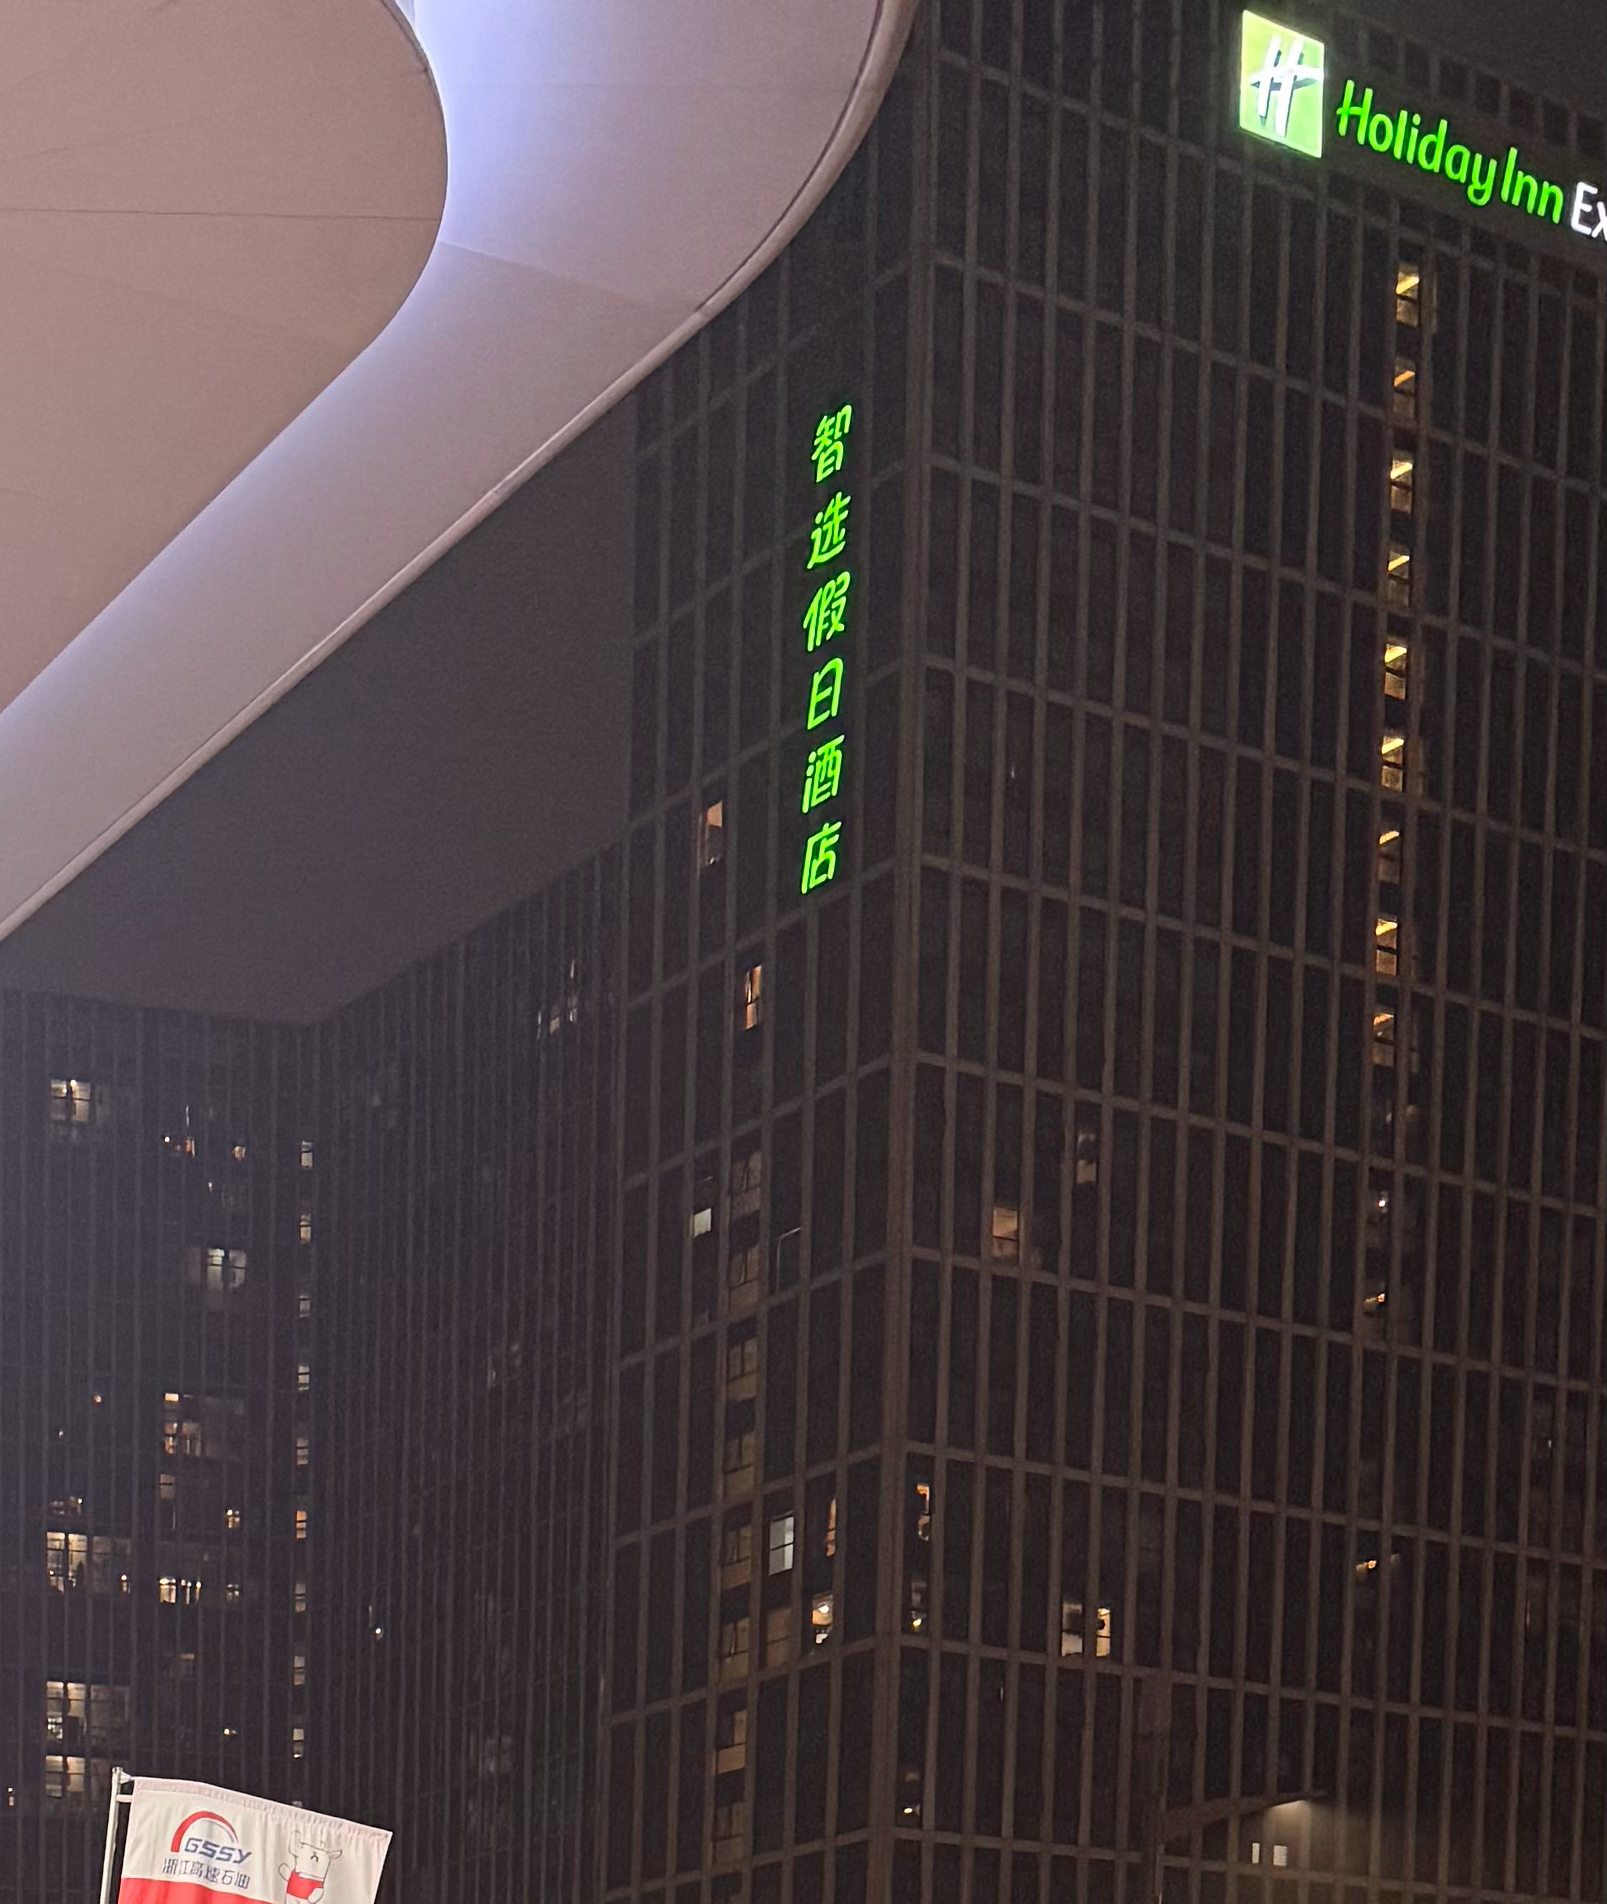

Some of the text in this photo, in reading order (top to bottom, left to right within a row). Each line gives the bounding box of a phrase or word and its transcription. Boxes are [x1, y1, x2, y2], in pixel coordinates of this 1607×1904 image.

[1336, 79, 1497, 206] Holiday
[1500, 147, 1564, 224] Inn
[801, 404, 852, 895] 智选假日酒店
[162, 1857, 251, 1890] 浙江高速石油
[184, 1837, 252, 1864] GSSY
